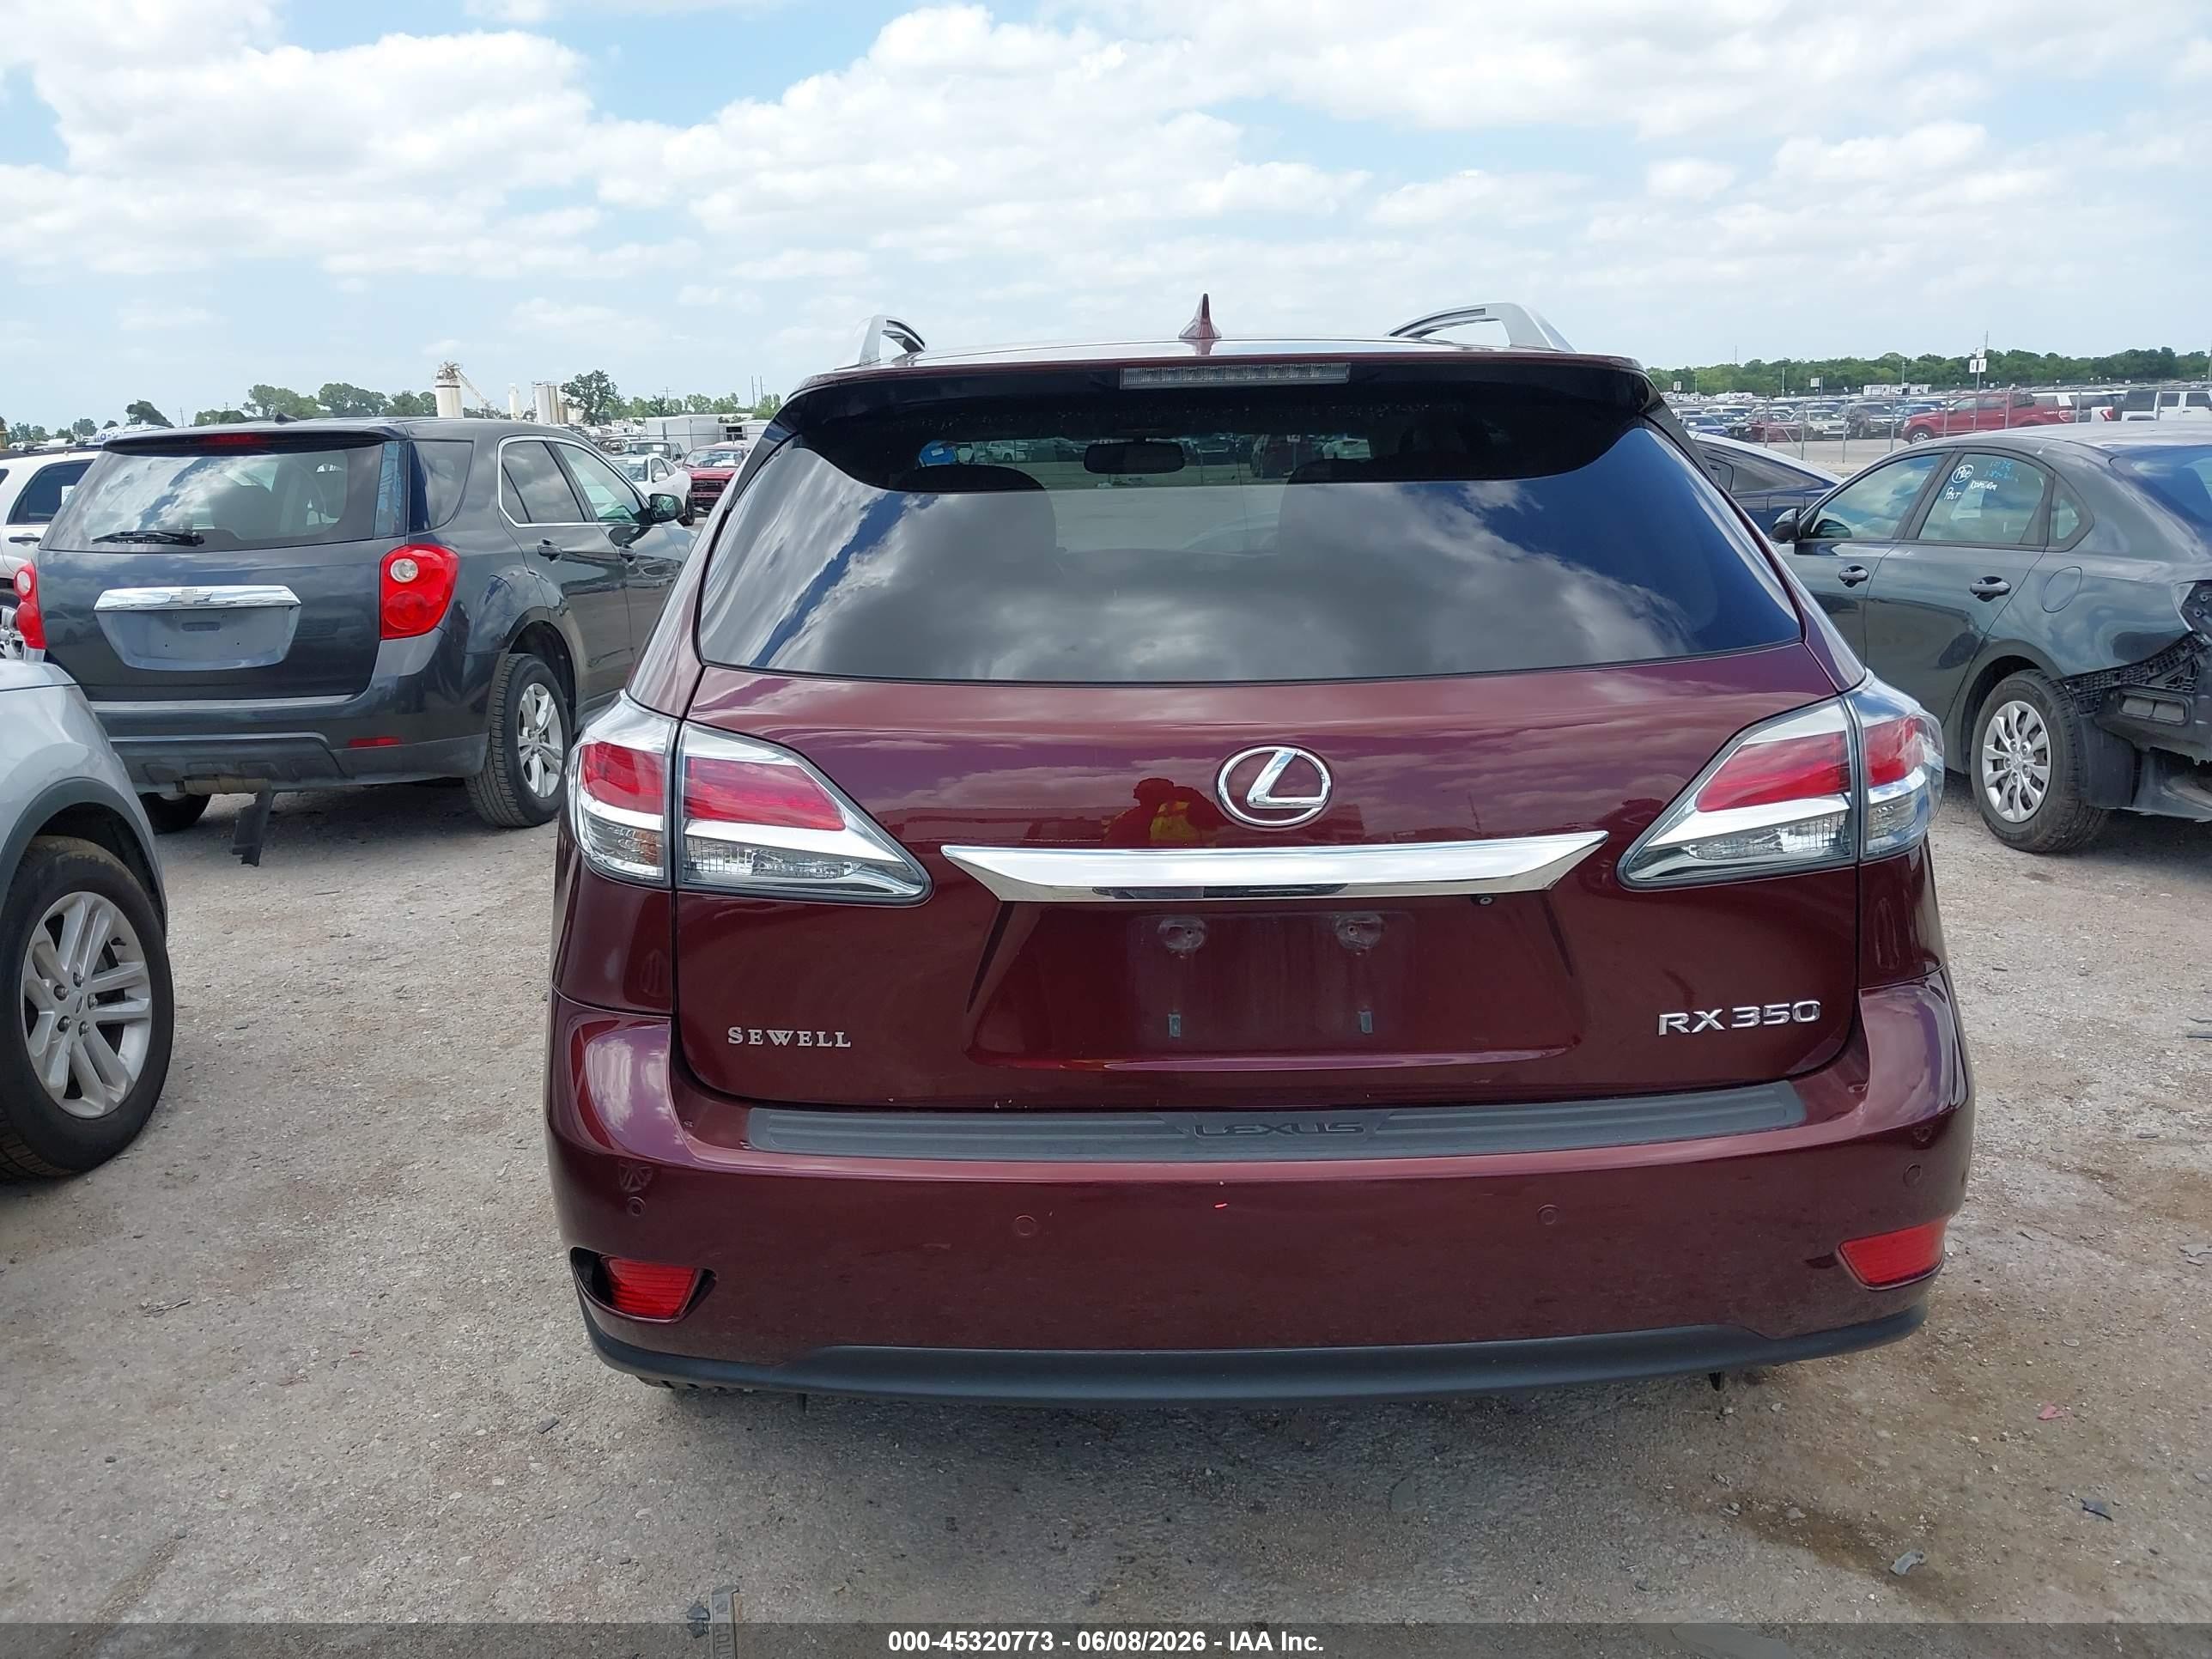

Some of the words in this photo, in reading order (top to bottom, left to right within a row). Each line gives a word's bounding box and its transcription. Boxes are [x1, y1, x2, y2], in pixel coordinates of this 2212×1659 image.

[1658, 1008, 1726, 1036] RX
[1731, 1000, 1821, 1029] 350
[727, 1026, 852, 1048] SEWELL
[1194, 1121, 1365, 1139] LEXUS
